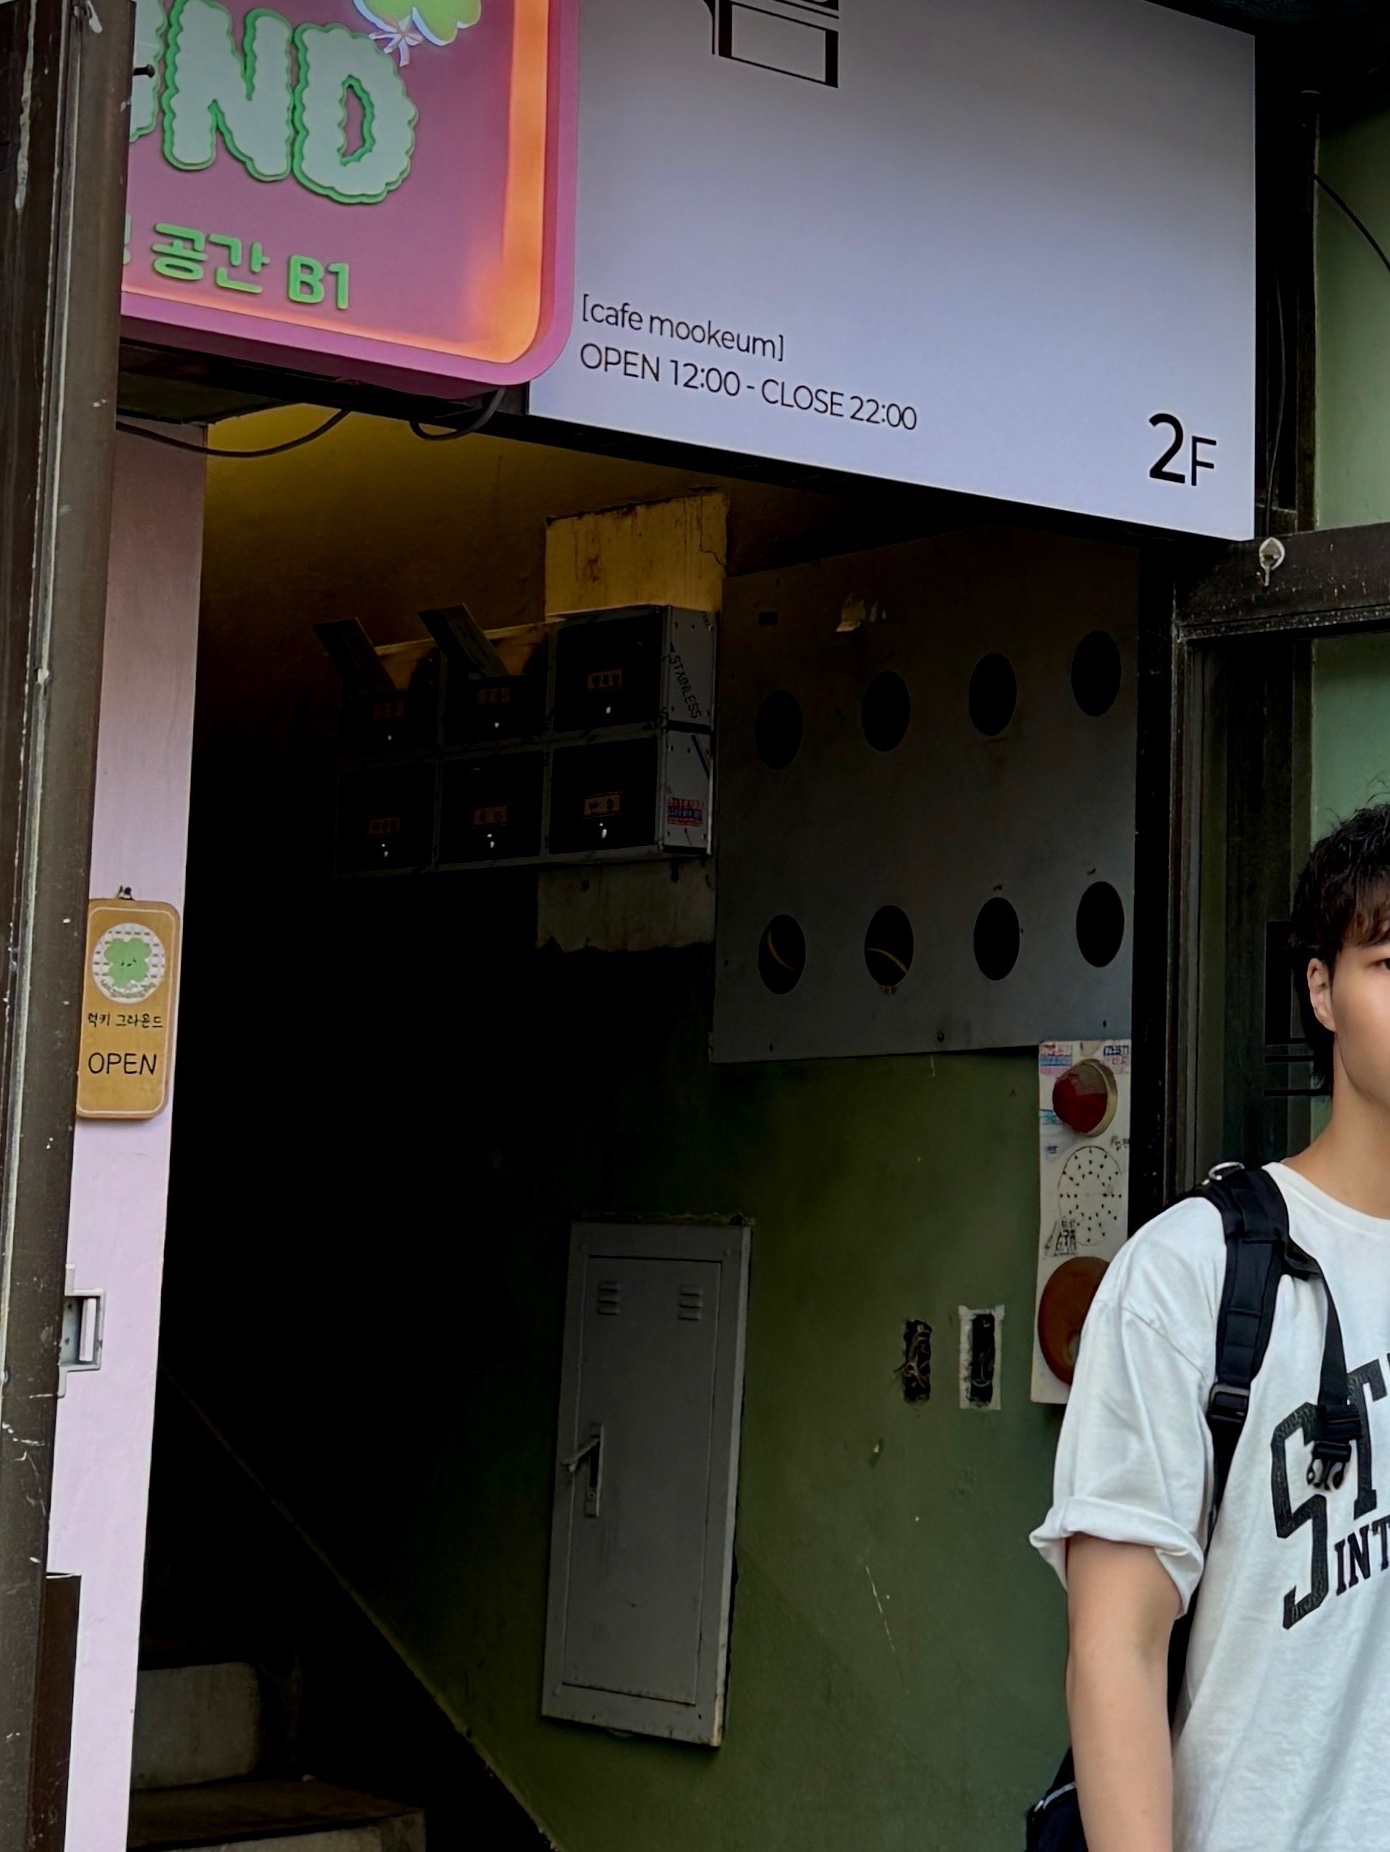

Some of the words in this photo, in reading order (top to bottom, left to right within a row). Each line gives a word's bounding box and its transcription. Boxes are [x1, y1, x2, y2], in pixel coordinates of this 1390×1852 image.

[151, 222, 271, 294] 공간
[287, 253, 350, 310] B1
[582, 293, 643, 331] [cafe
[649, 313, 784, 362] mookeum]
[580, 342, 660, 383] OPEN
[669, 359, 741, 397] 12:00
[761, 378, 845, 418] CLOSE
[849, 396, 917, 431] 22:00
[1148, 412, 1217, 487] 2F
[87, 1052, 157, 1075] OPEN
